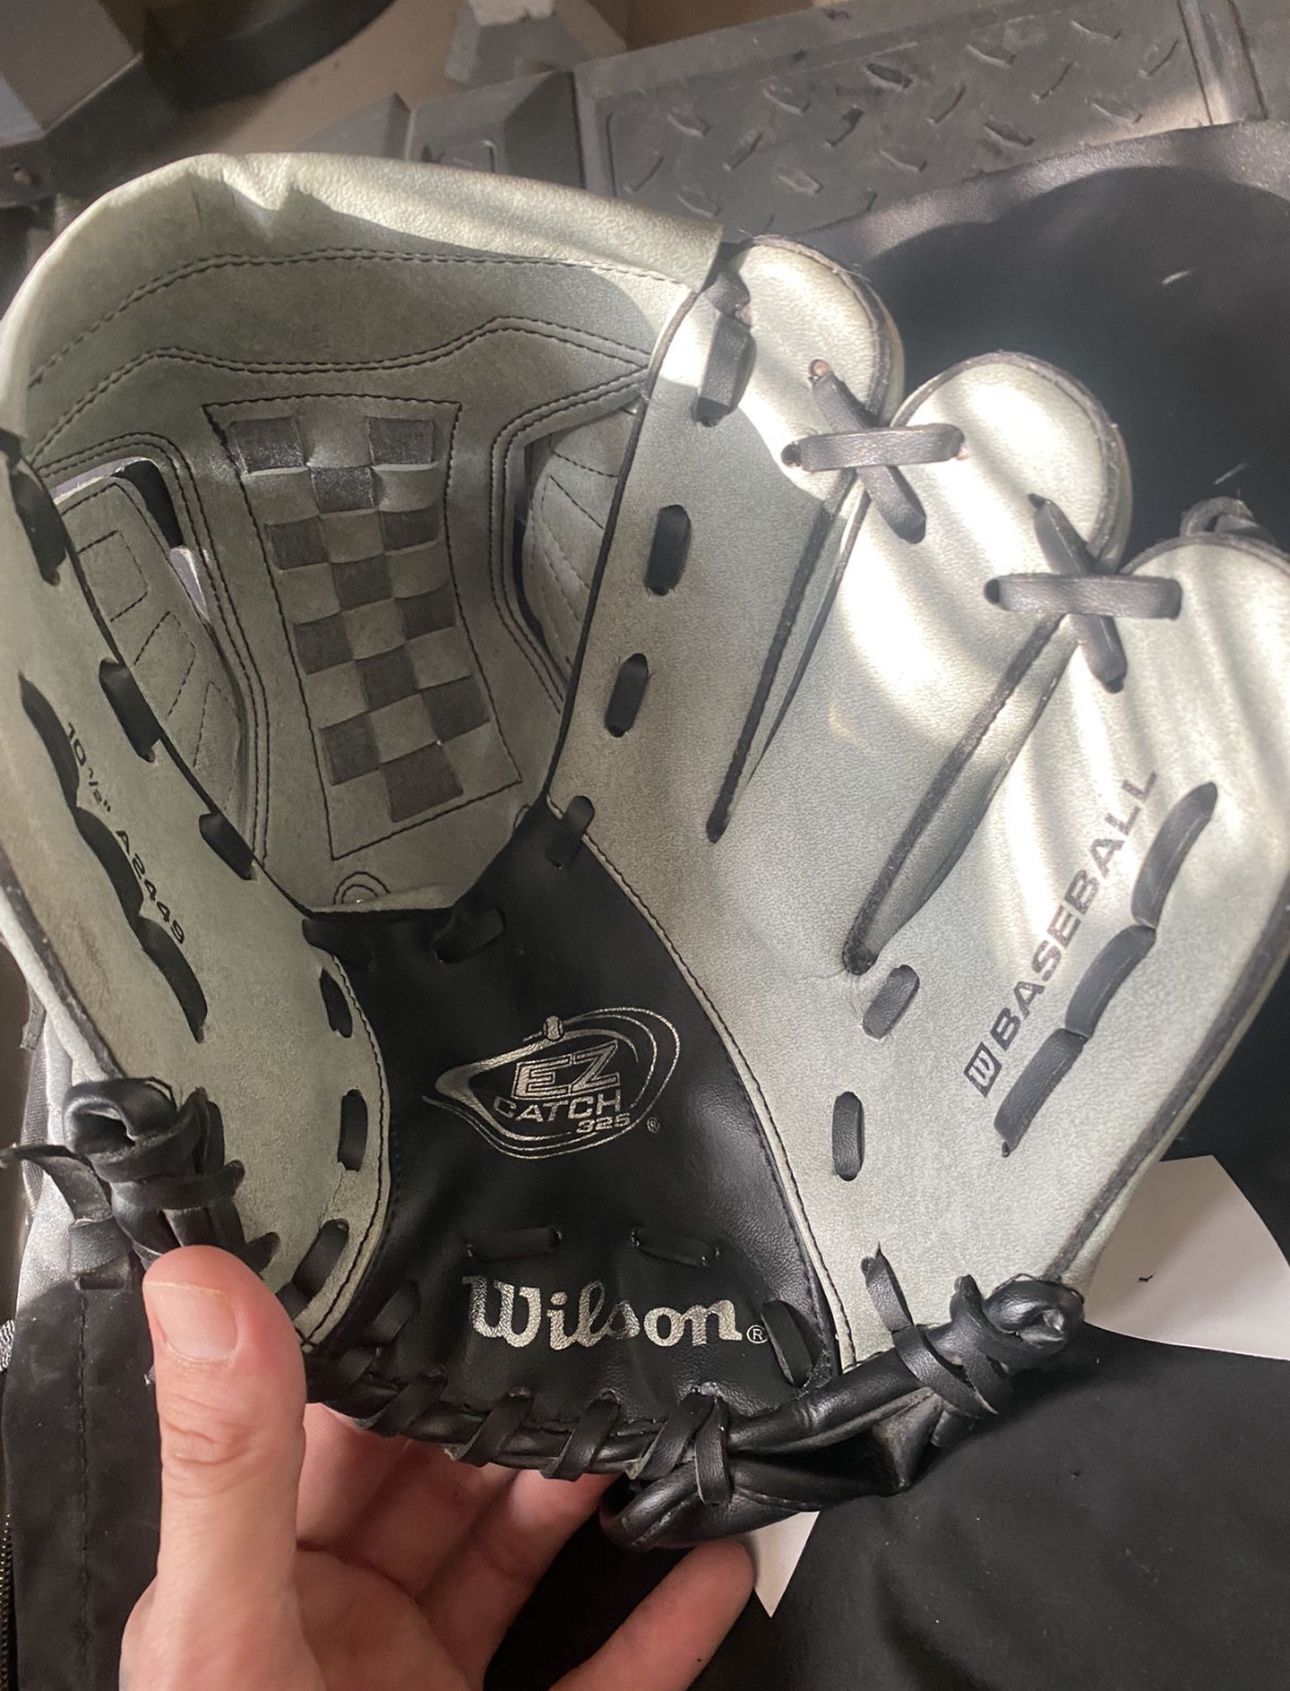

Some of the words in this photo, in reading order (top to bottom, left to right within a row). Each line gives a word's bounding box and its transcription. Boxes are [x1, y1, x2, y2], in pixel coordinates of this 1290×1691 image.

[116, 830, 185, 944] A2449
[991, 771, 1157, 1051] BASEBALL
[511, 1040, 620, 1102] EZ
[494, 1089, 621, 1122] CATCH
[576, 1112, 631, 1134] 325
